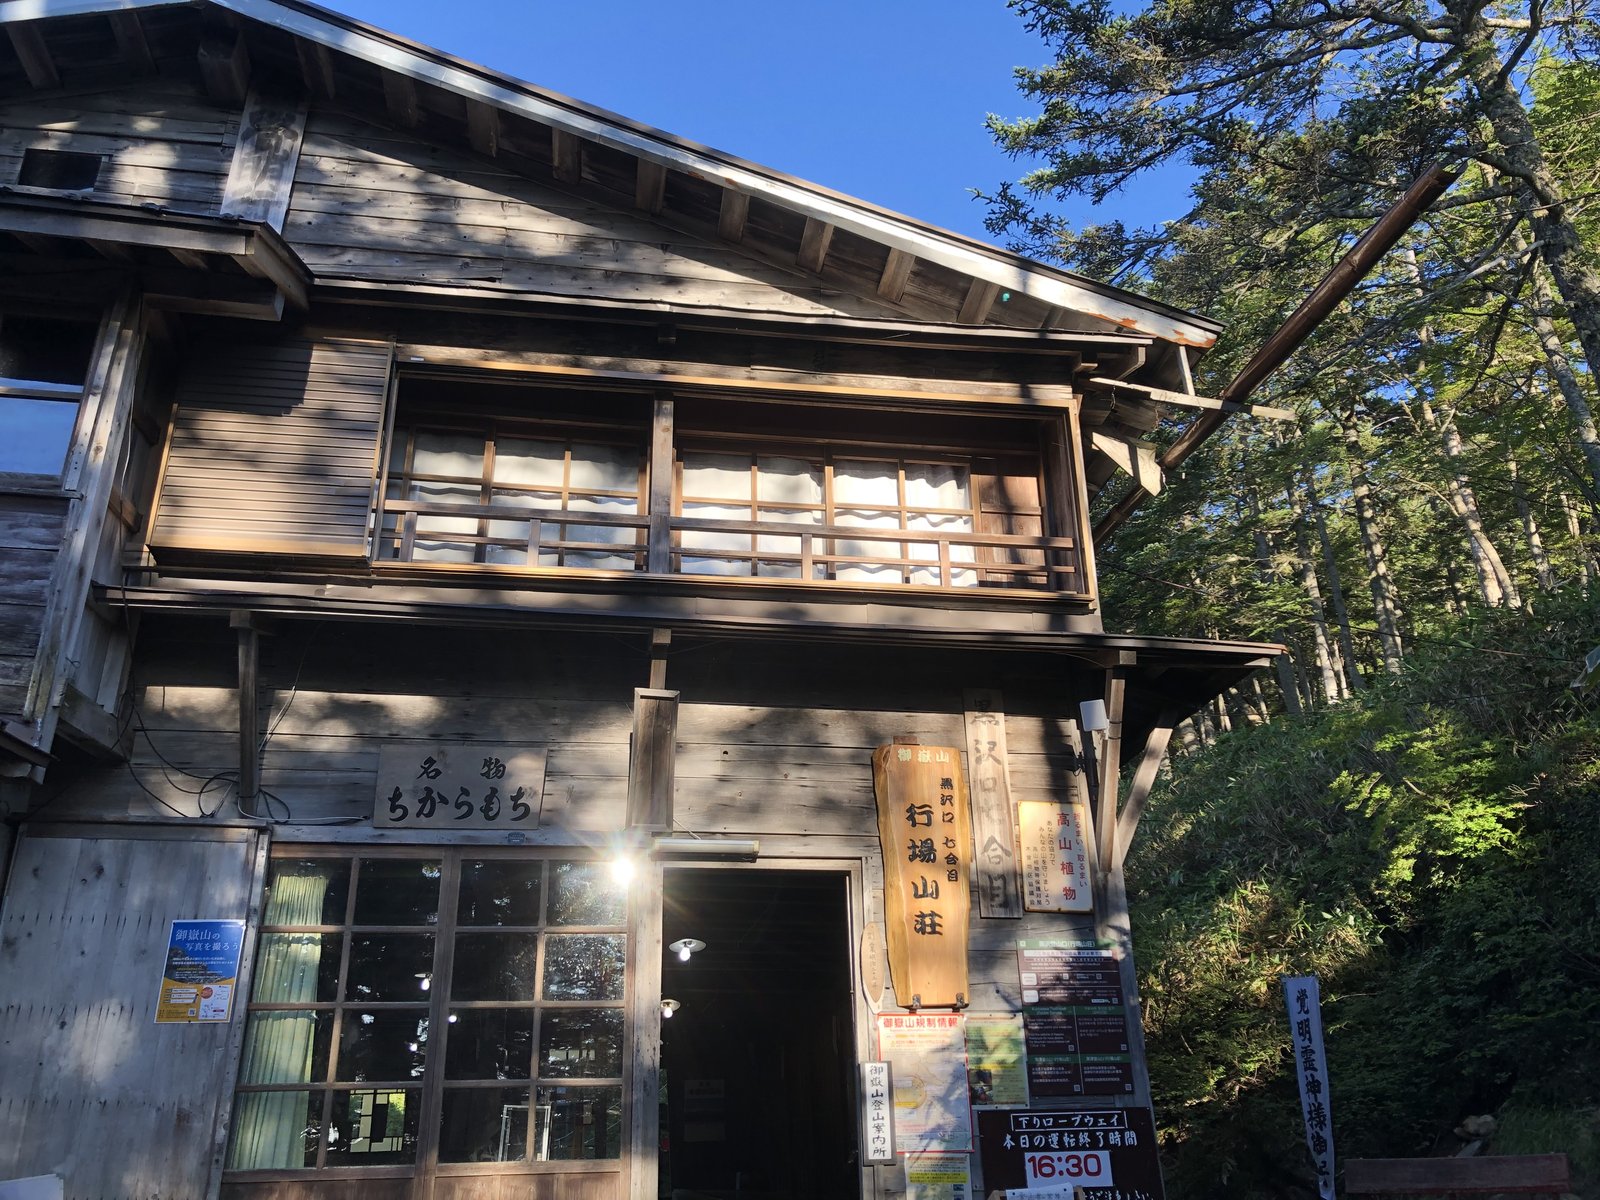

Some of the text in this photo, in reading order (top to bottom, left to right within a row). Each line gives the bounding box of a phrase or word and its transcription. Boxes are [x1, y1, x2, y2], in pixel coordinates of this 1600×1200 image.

[898, 748, 949, 763] 御嶽山
[416, 756, 507, 780] 名物
[388, 786, 531, 822] ちからもち
[1056, 813, 1077, 900] 高山植物
[906, 803, 943, 936] 行場山荘
[175, 929, 220, 941] 御嶽山の
[185, 942, 239, 951] 写真を撮ろう
[869, 1065, 887, 1158] 御嶽山登山案内所
[1018, 1114, 1119, 1129] 下りロープウェイ
[1003, 1131, 1138, 1150] 本日の運転終了時間
[1027, 1154, 1102, 1179] 16:30
